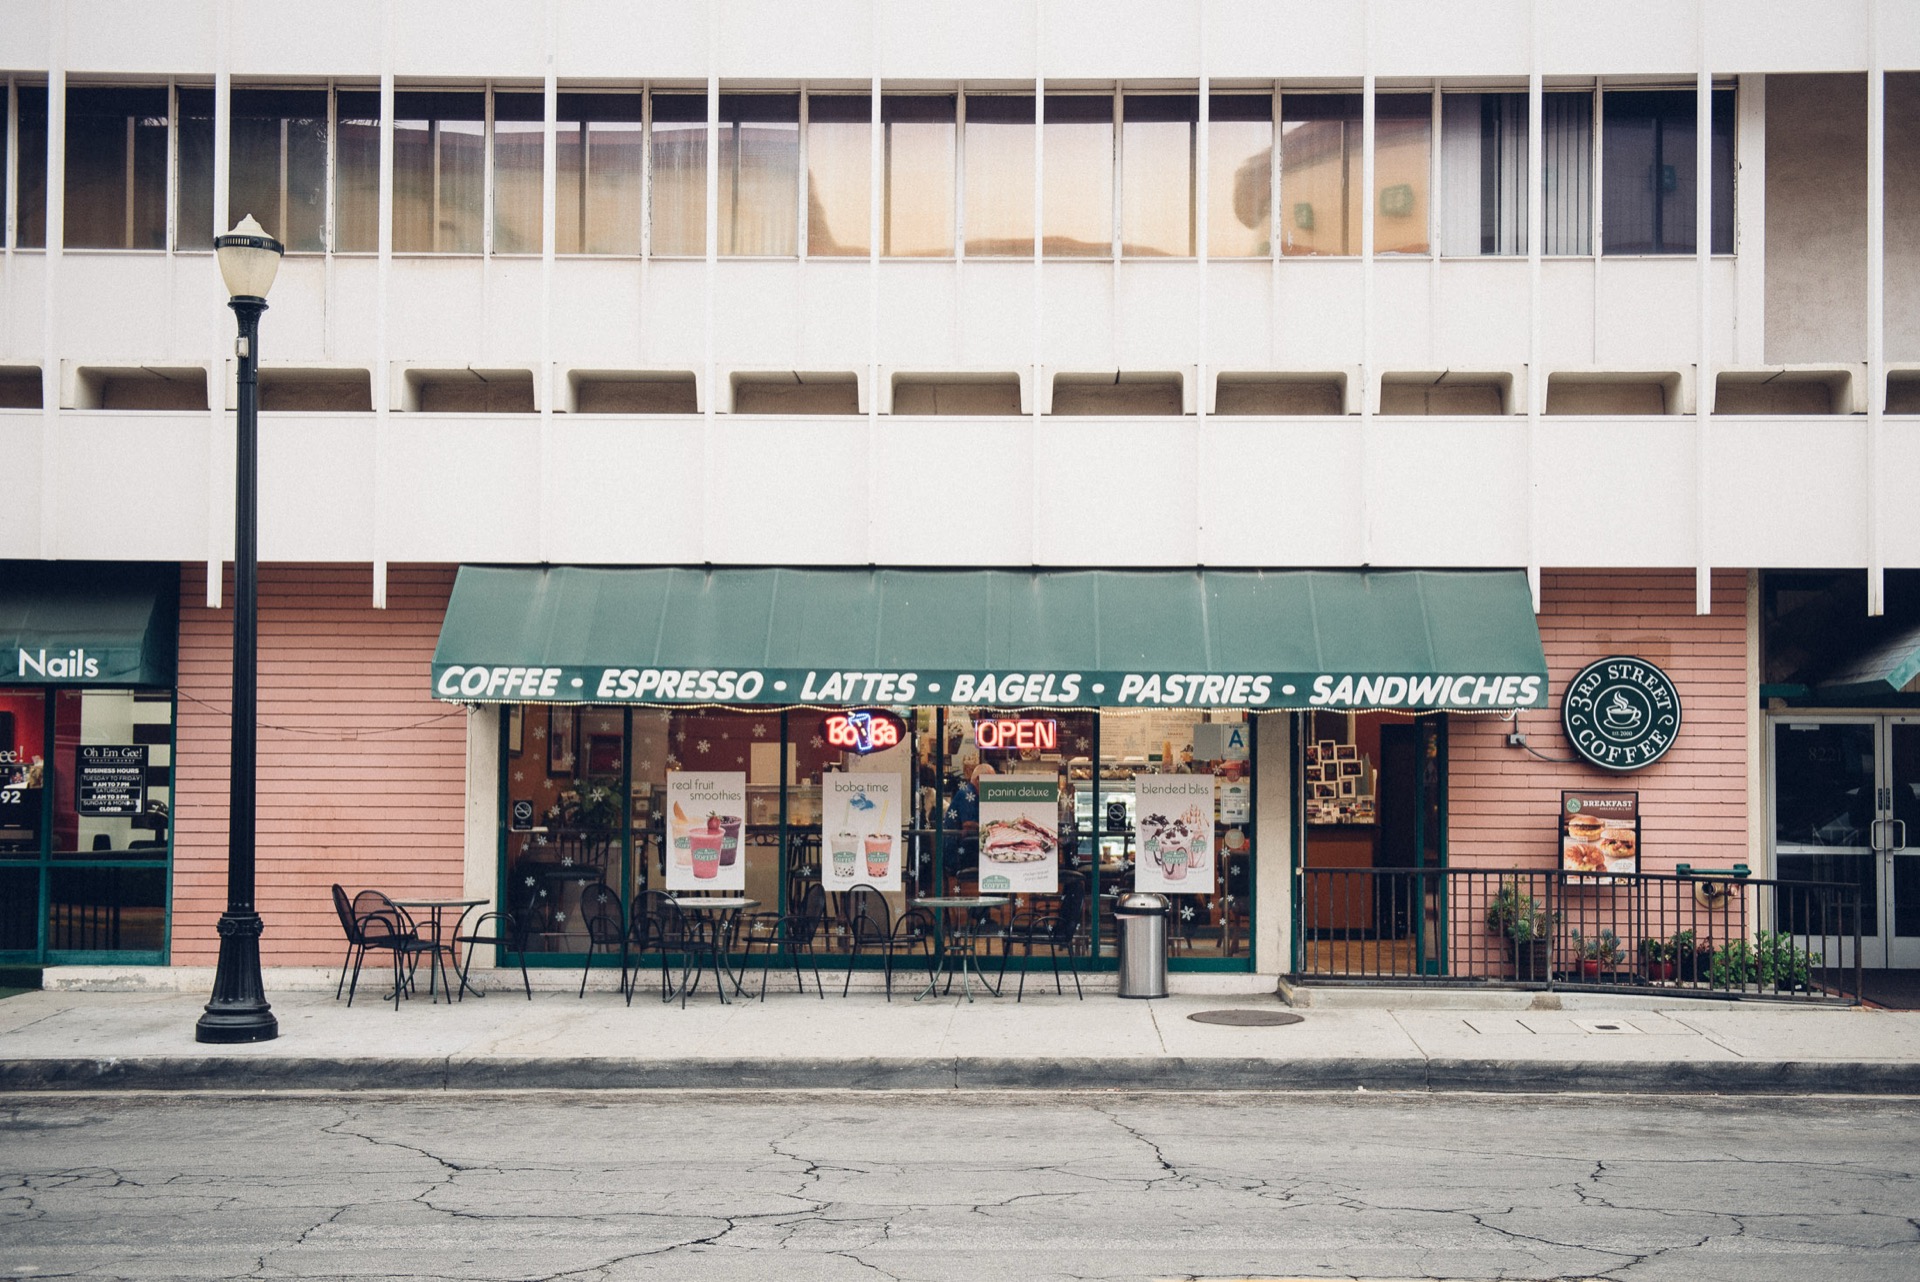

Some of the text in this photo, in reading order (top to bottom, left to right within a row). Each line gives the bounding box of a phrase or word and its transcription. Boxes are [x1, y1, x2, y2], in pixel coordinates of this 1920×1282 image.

[18, 648, 99, 677] Nails
[437, 665, 1541, 706] COFFEE ESPRESSO LATTES BAGELS PASTRIES SANDWICHES
[1570, 664, 1673, 712] 3RD STREET
[978, 721, 1054, 748] OPEN
[1228, 730, 1244, 747] A
[83, 747, 142, 757] Oh Em Gee!
[1579, 729, 1669, 764] COFFEE
[671, 779, 714, 790] real fruit
[835, 781, 889, 792] boba time
[1142, 783, 1209, 795] blended bliss
[690, 790, 742, 800] smoothies
[988, 786, 1050, 799] panini deluxe
